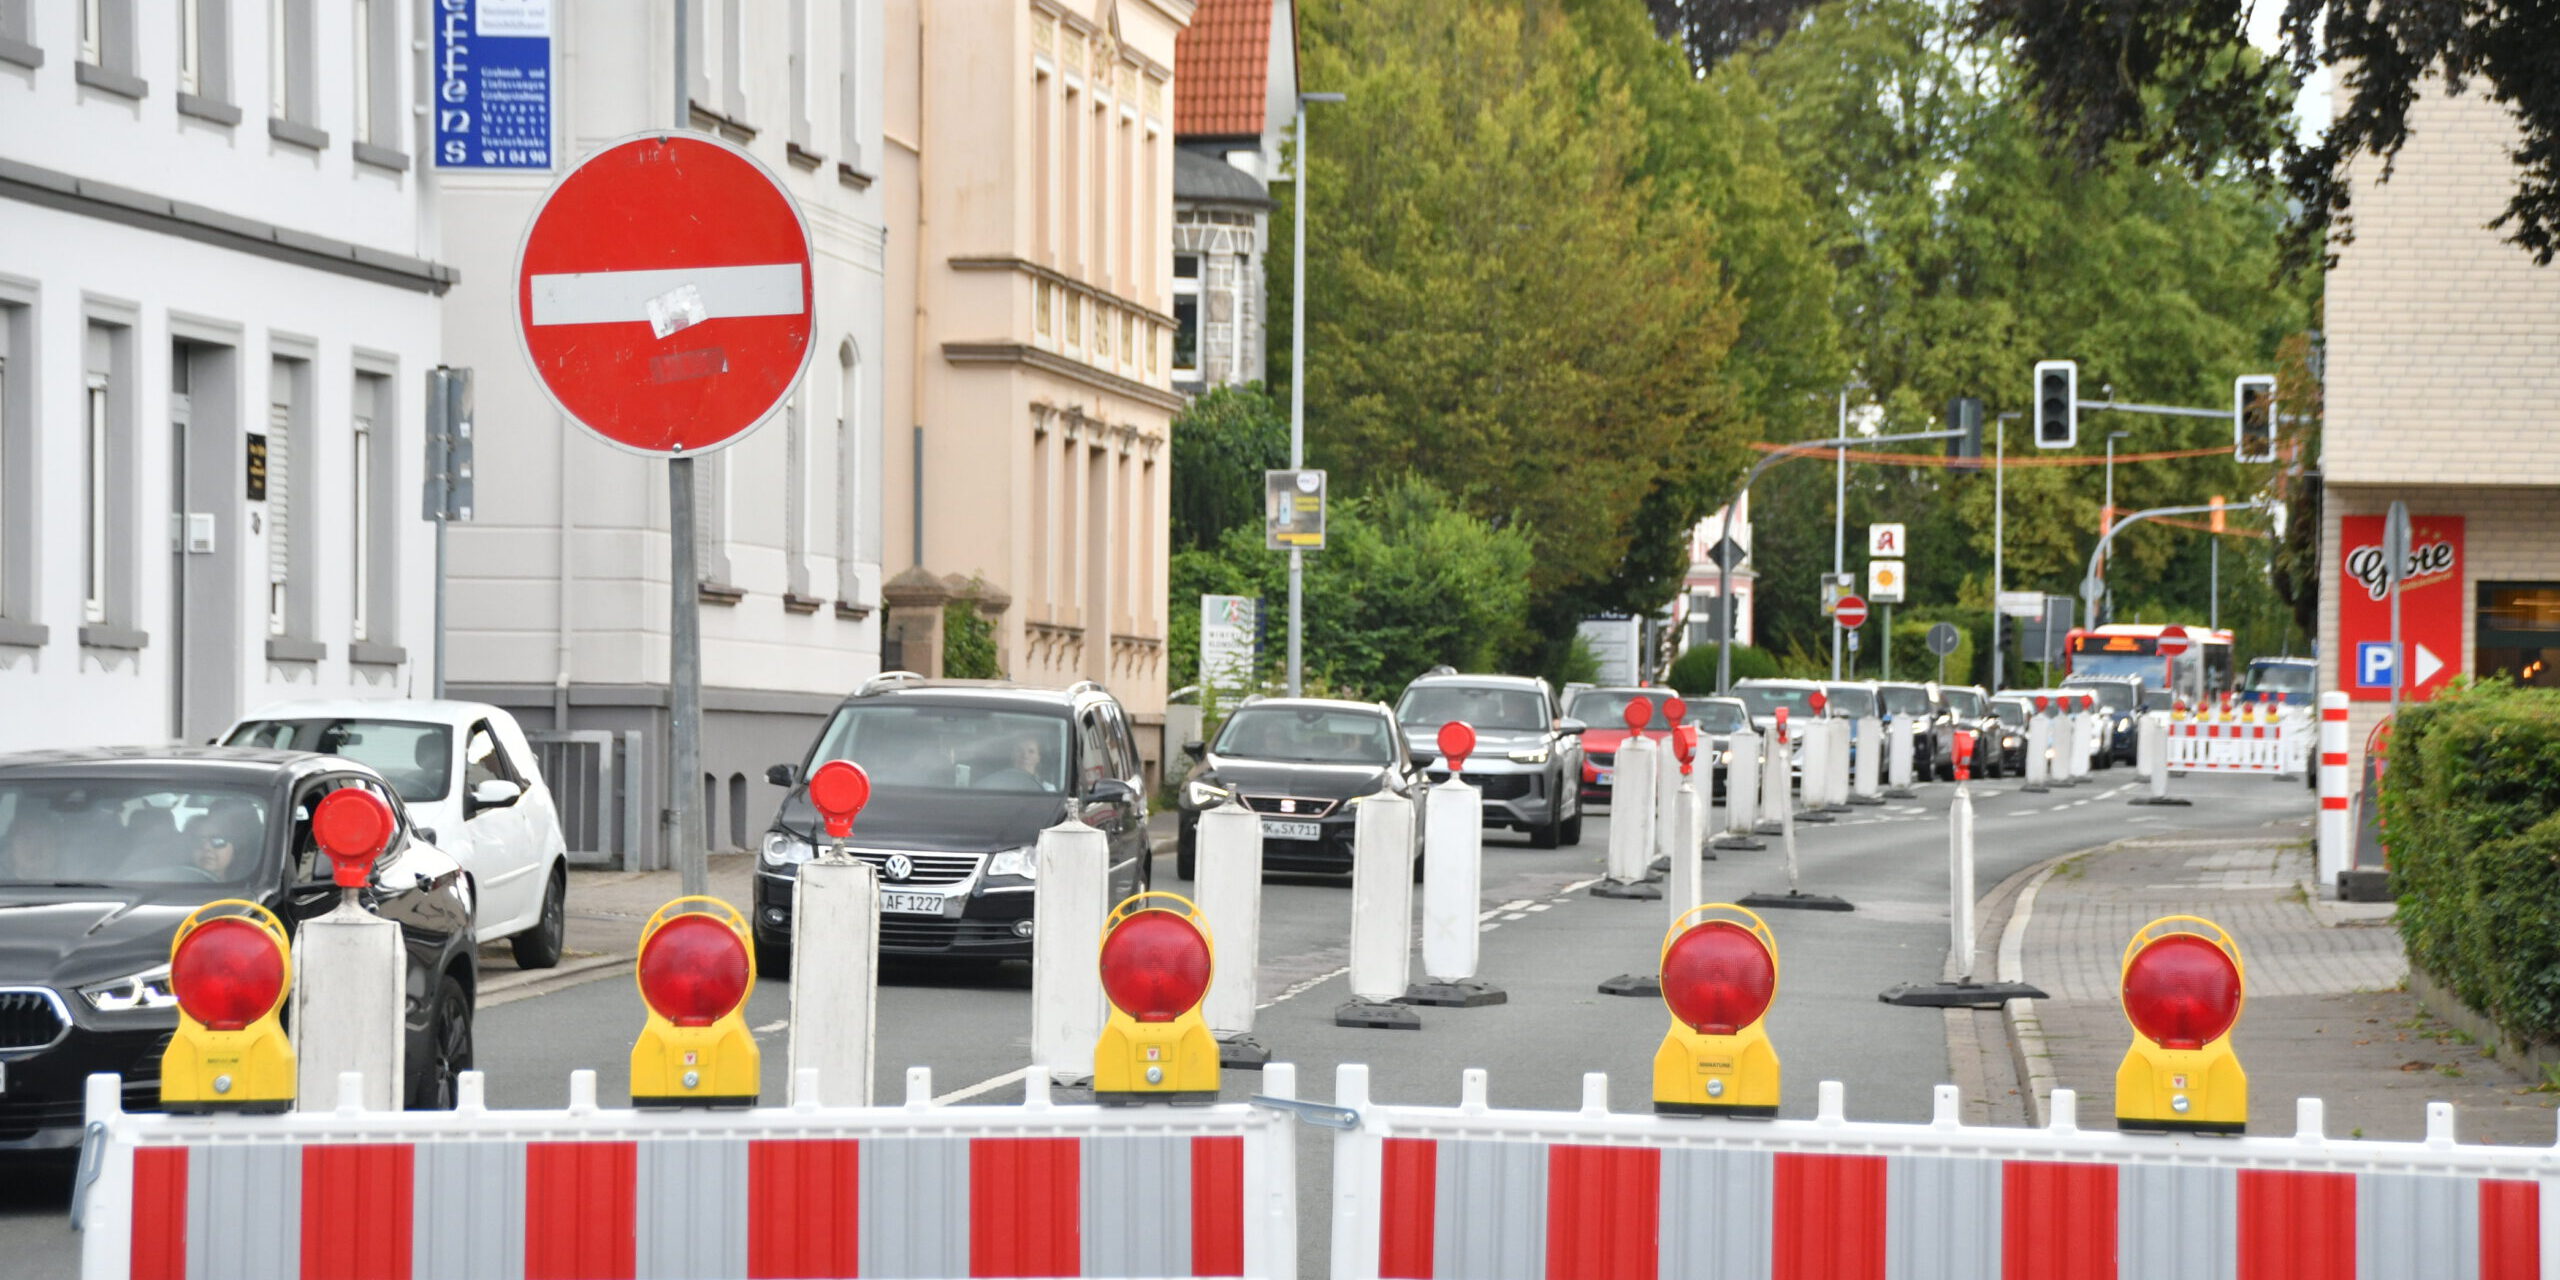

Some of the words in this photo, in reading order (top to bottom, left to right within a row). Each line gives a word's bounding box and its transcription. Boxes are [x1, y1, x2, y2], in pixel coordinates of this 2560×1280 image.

[2347, 542, 2454, 600] Gote
[2365, 647, 2394, 683] P
[1281, 824, 1295, 835] SX
[1297, 825, 1318, 837] 711
[886, 895, 905, 910] AF
[907, 896, 942, 912] 1227
